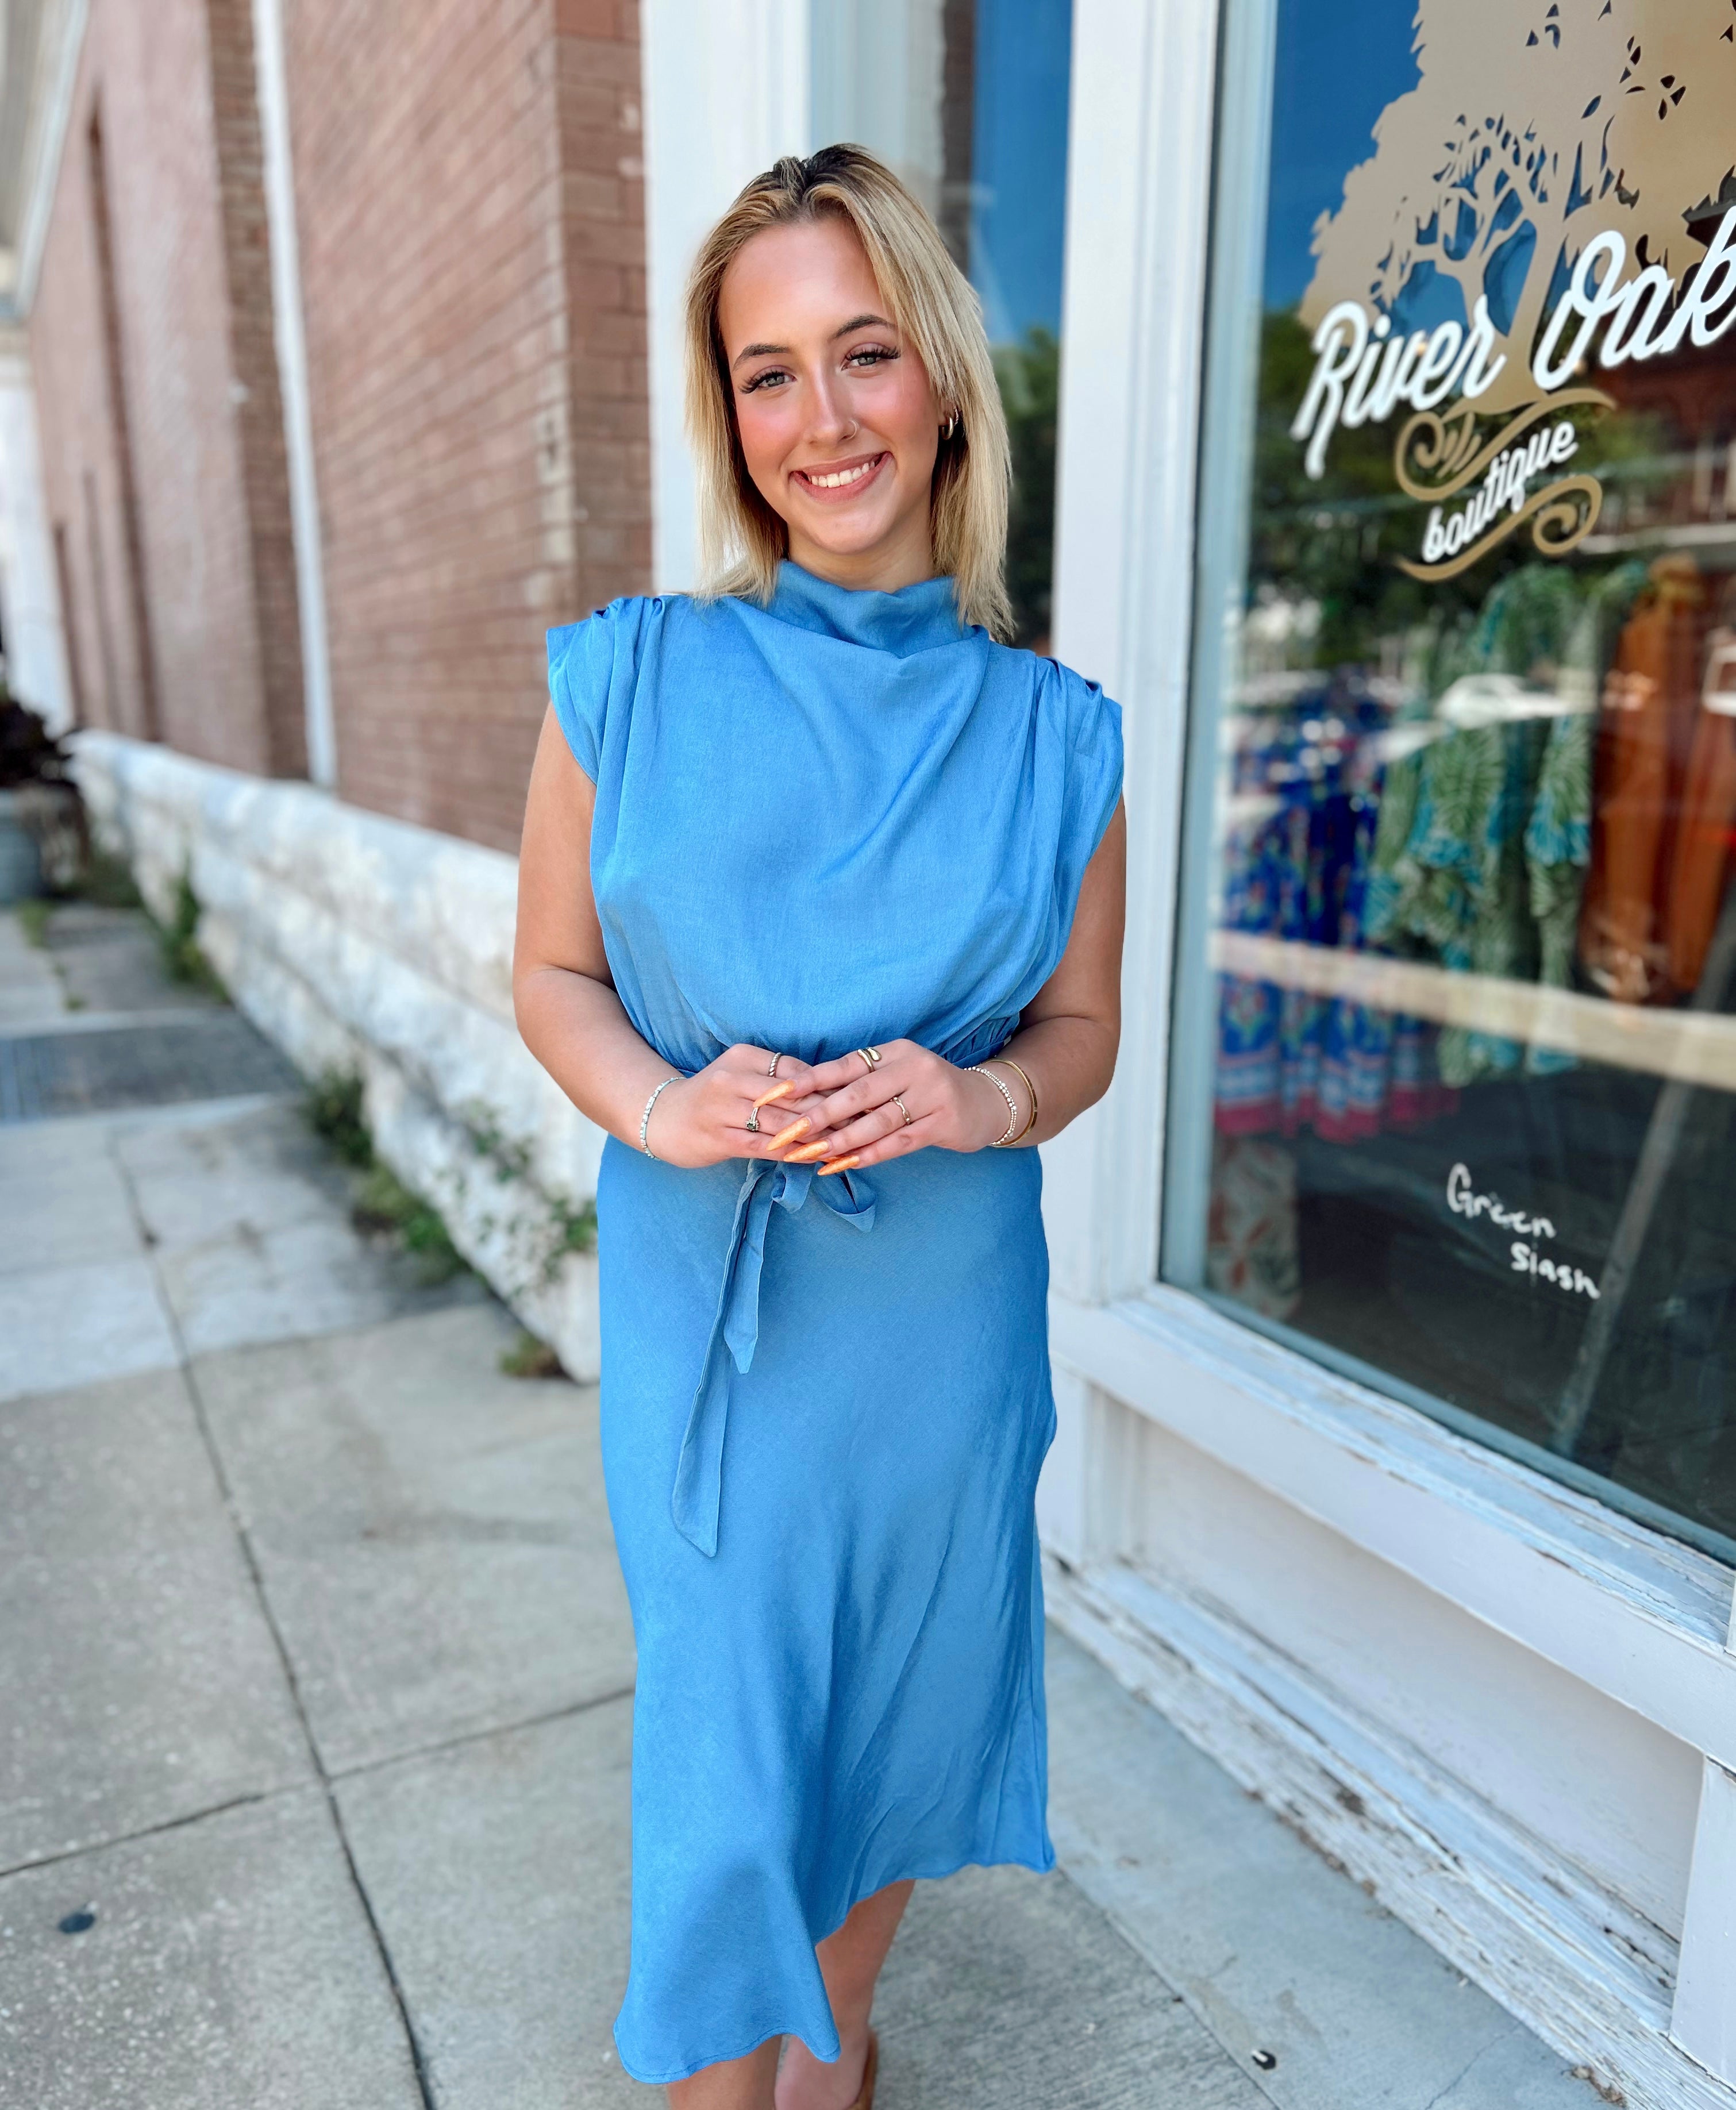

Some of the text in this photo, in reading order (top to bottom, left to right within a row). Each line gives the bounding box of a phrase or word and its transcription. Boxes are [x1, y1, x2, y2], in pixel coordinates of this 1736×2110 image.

[1291, 294, 1507, 479] River
[1422, 421, 1578, 562] boutique
[1447, 1163, 1556, 1238] Green
